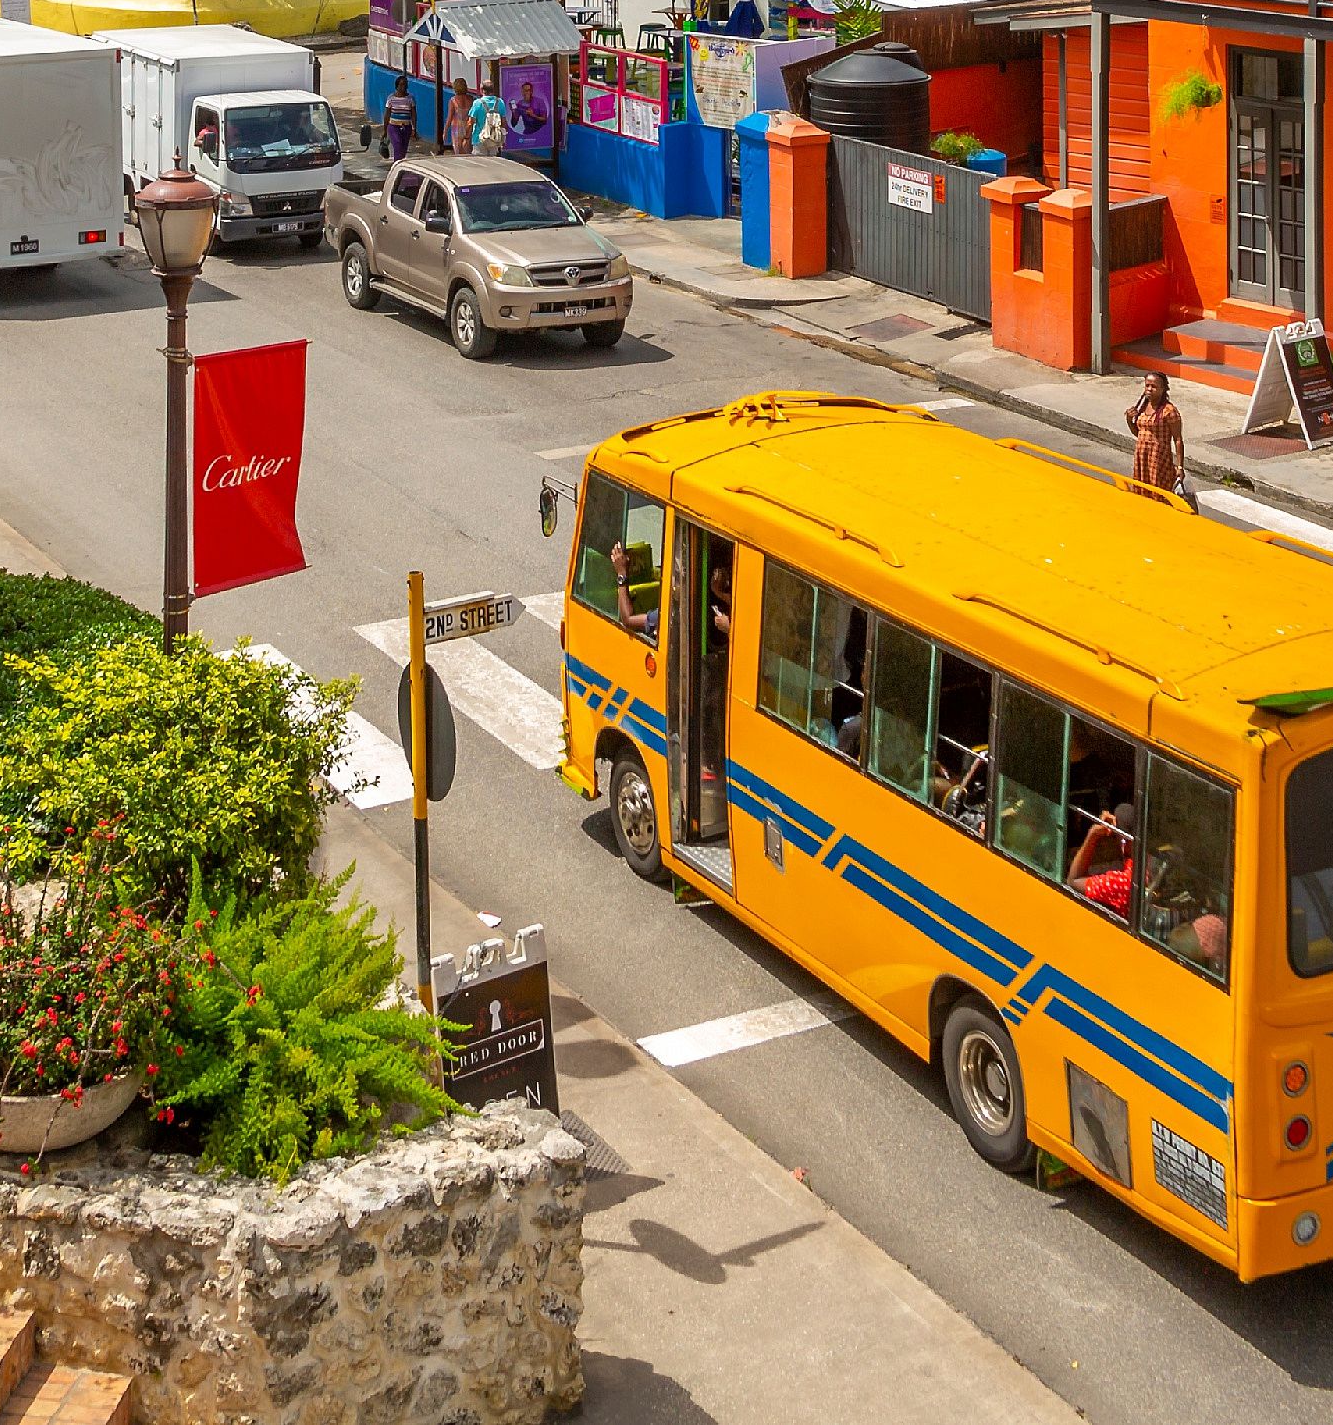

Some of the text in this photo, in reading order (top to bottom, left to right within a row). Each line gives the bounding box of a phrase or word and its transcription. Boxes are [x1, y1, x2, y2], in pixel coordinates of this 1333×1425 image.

[891, 166, 929, 184] NO PARKING
[891, 181, 929, 199] 24hr DELIVERY
[897, 194, 922, 208] FIRE EXIT
[202, 454, 292, 492] Cartier
[460, 599, 513, 632] STREET
[459, 1030, 538, 1068] RED DOOR
